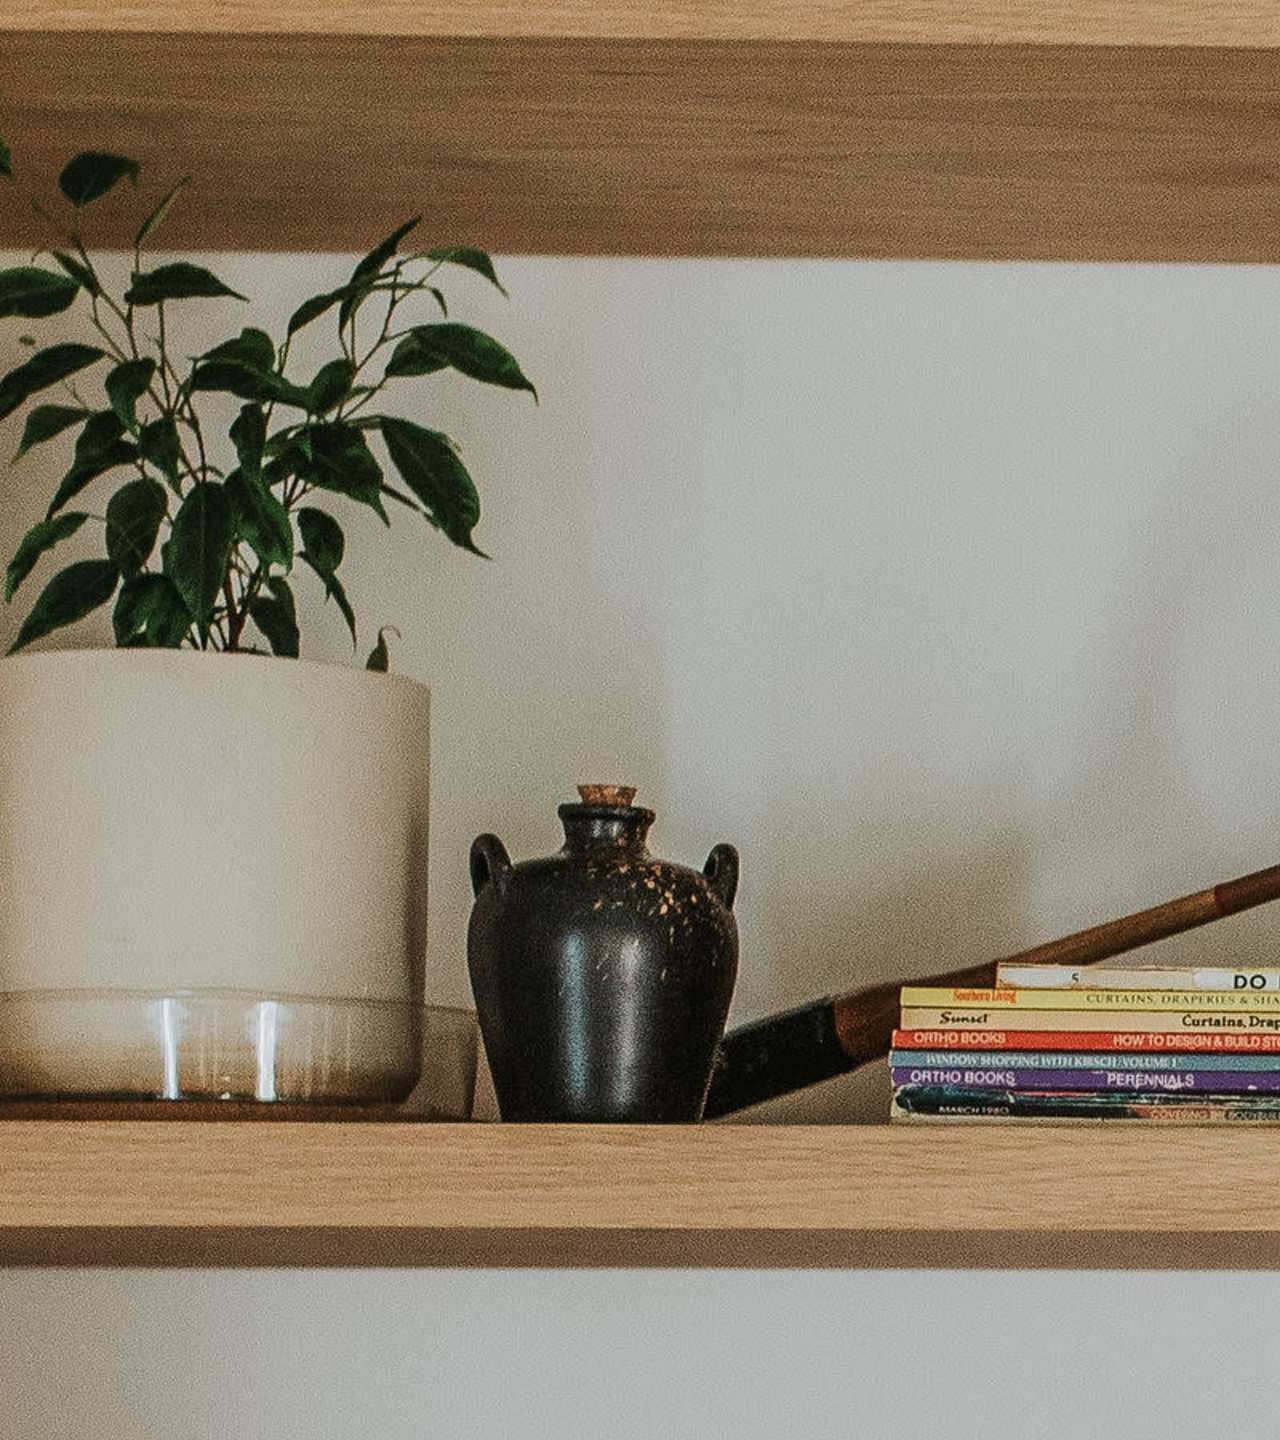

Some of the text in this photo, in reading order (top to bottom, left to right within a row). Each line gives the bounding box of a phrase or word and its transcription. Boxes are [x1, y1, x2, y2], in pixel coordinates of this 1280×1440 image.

[1233, 974, 1266, 990] DO
[914, 1031, 956, 1043] ORTHO
[961, 1031, 1006, 1043] BOOKS
[1112, 1034, 1144, 1047] HOW
[1148, 1035, 1164, 1047] TO
[1166, 1035, 1212, 1047] DESIGN
[1214, 1035, 1222, 1047] &
[1224, 1035, 1261, 1048] BUILD
[910, 1071, 1195, 1087] ORTHO BOOKS PERENNIALS
